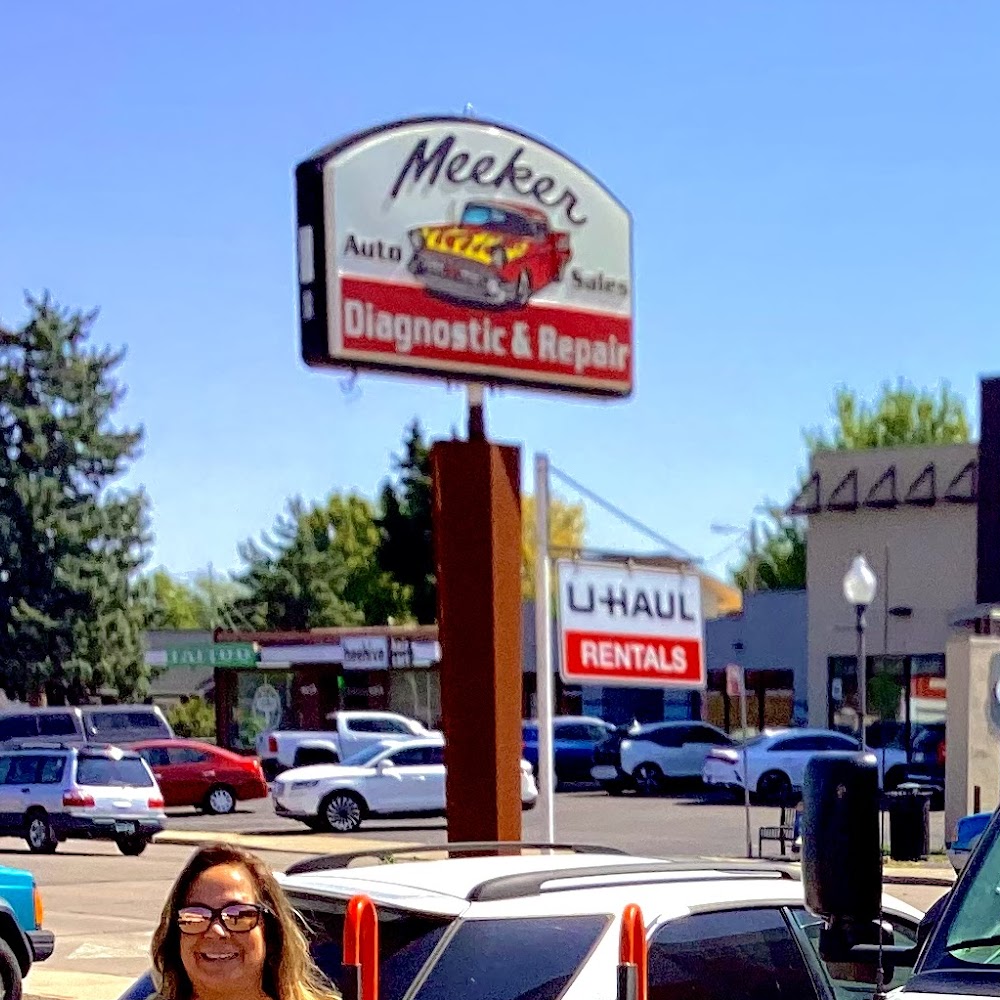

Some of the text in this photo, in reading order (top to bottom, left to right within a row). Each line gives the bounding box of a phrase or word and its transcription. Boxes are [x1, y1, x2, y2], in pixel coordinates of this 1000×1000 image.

[391, 136, 587, 225] Meeker
[344, 233, 628, 297] Auto Sales
[343, 299, 630, 373] Diagnostic & Repair
[566, 581, 695, 622] U-HAUL
[580, 639, 689, 675] RENTALS
